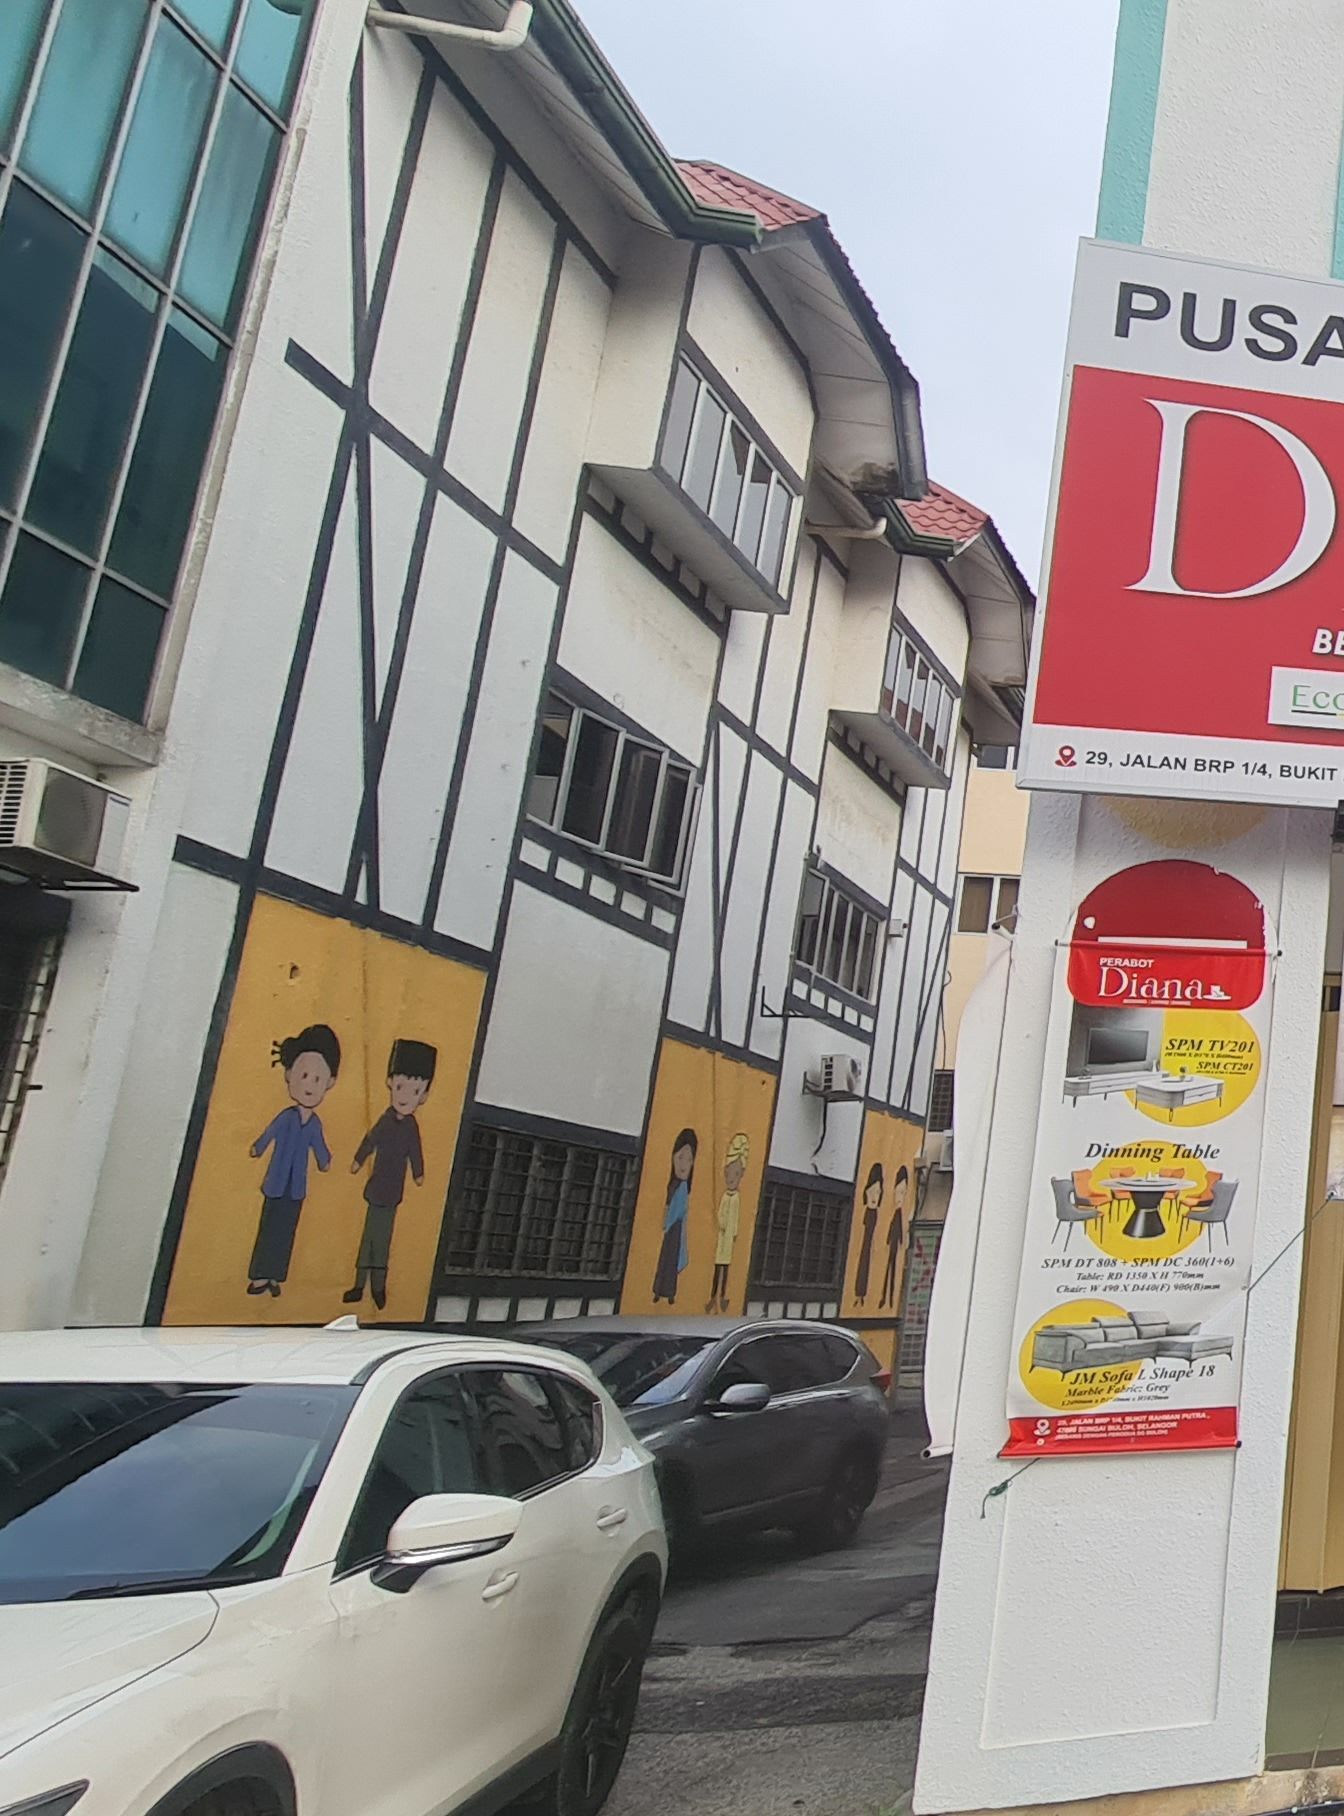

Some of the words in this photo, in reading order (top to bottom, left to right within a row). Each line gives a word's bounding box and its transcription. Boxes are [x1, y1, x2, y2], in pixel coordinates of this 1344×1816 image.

[1086, 751, 1113, 769] 29,
[1119, 753, 1187, 771] JALAN
[1194, 758, 1235, 773] BRP
[1241, 762, 1273, 779] 1/4,
[1279, 765, 1338, 782] BUKIT
[1100, 957, 1154, 968] PERABOT
[1098, 966, 1204, 1000] Diana
[1165, 1038, 1203, 1051] SPM
[1208, 1040, 1255, 1053] TV201
[1085, 1143, 1165, 1163] Dinning
[1172, 1143, 1220, 1160] Table
[1041, 1258, 1072, 1269] SPM
[1074, 1258, 1095, 1268] DT
[1131, 1257, 1159, 1268] SPM
[1163, 1257, 1184, 1267] DC
[1069, 1371, 1097, 1386] JM
[1099, 1369, 1134, 1385] Sofa
[1137, 1368, 1146, 1380] L
[1150, 1367, 1194, 1382] Shape
[1199, 1364, 1216, 1377] 18
[1065, 1385, 1104, 1398] Marble
[1146, 1383, 1171, 1394] Grey
